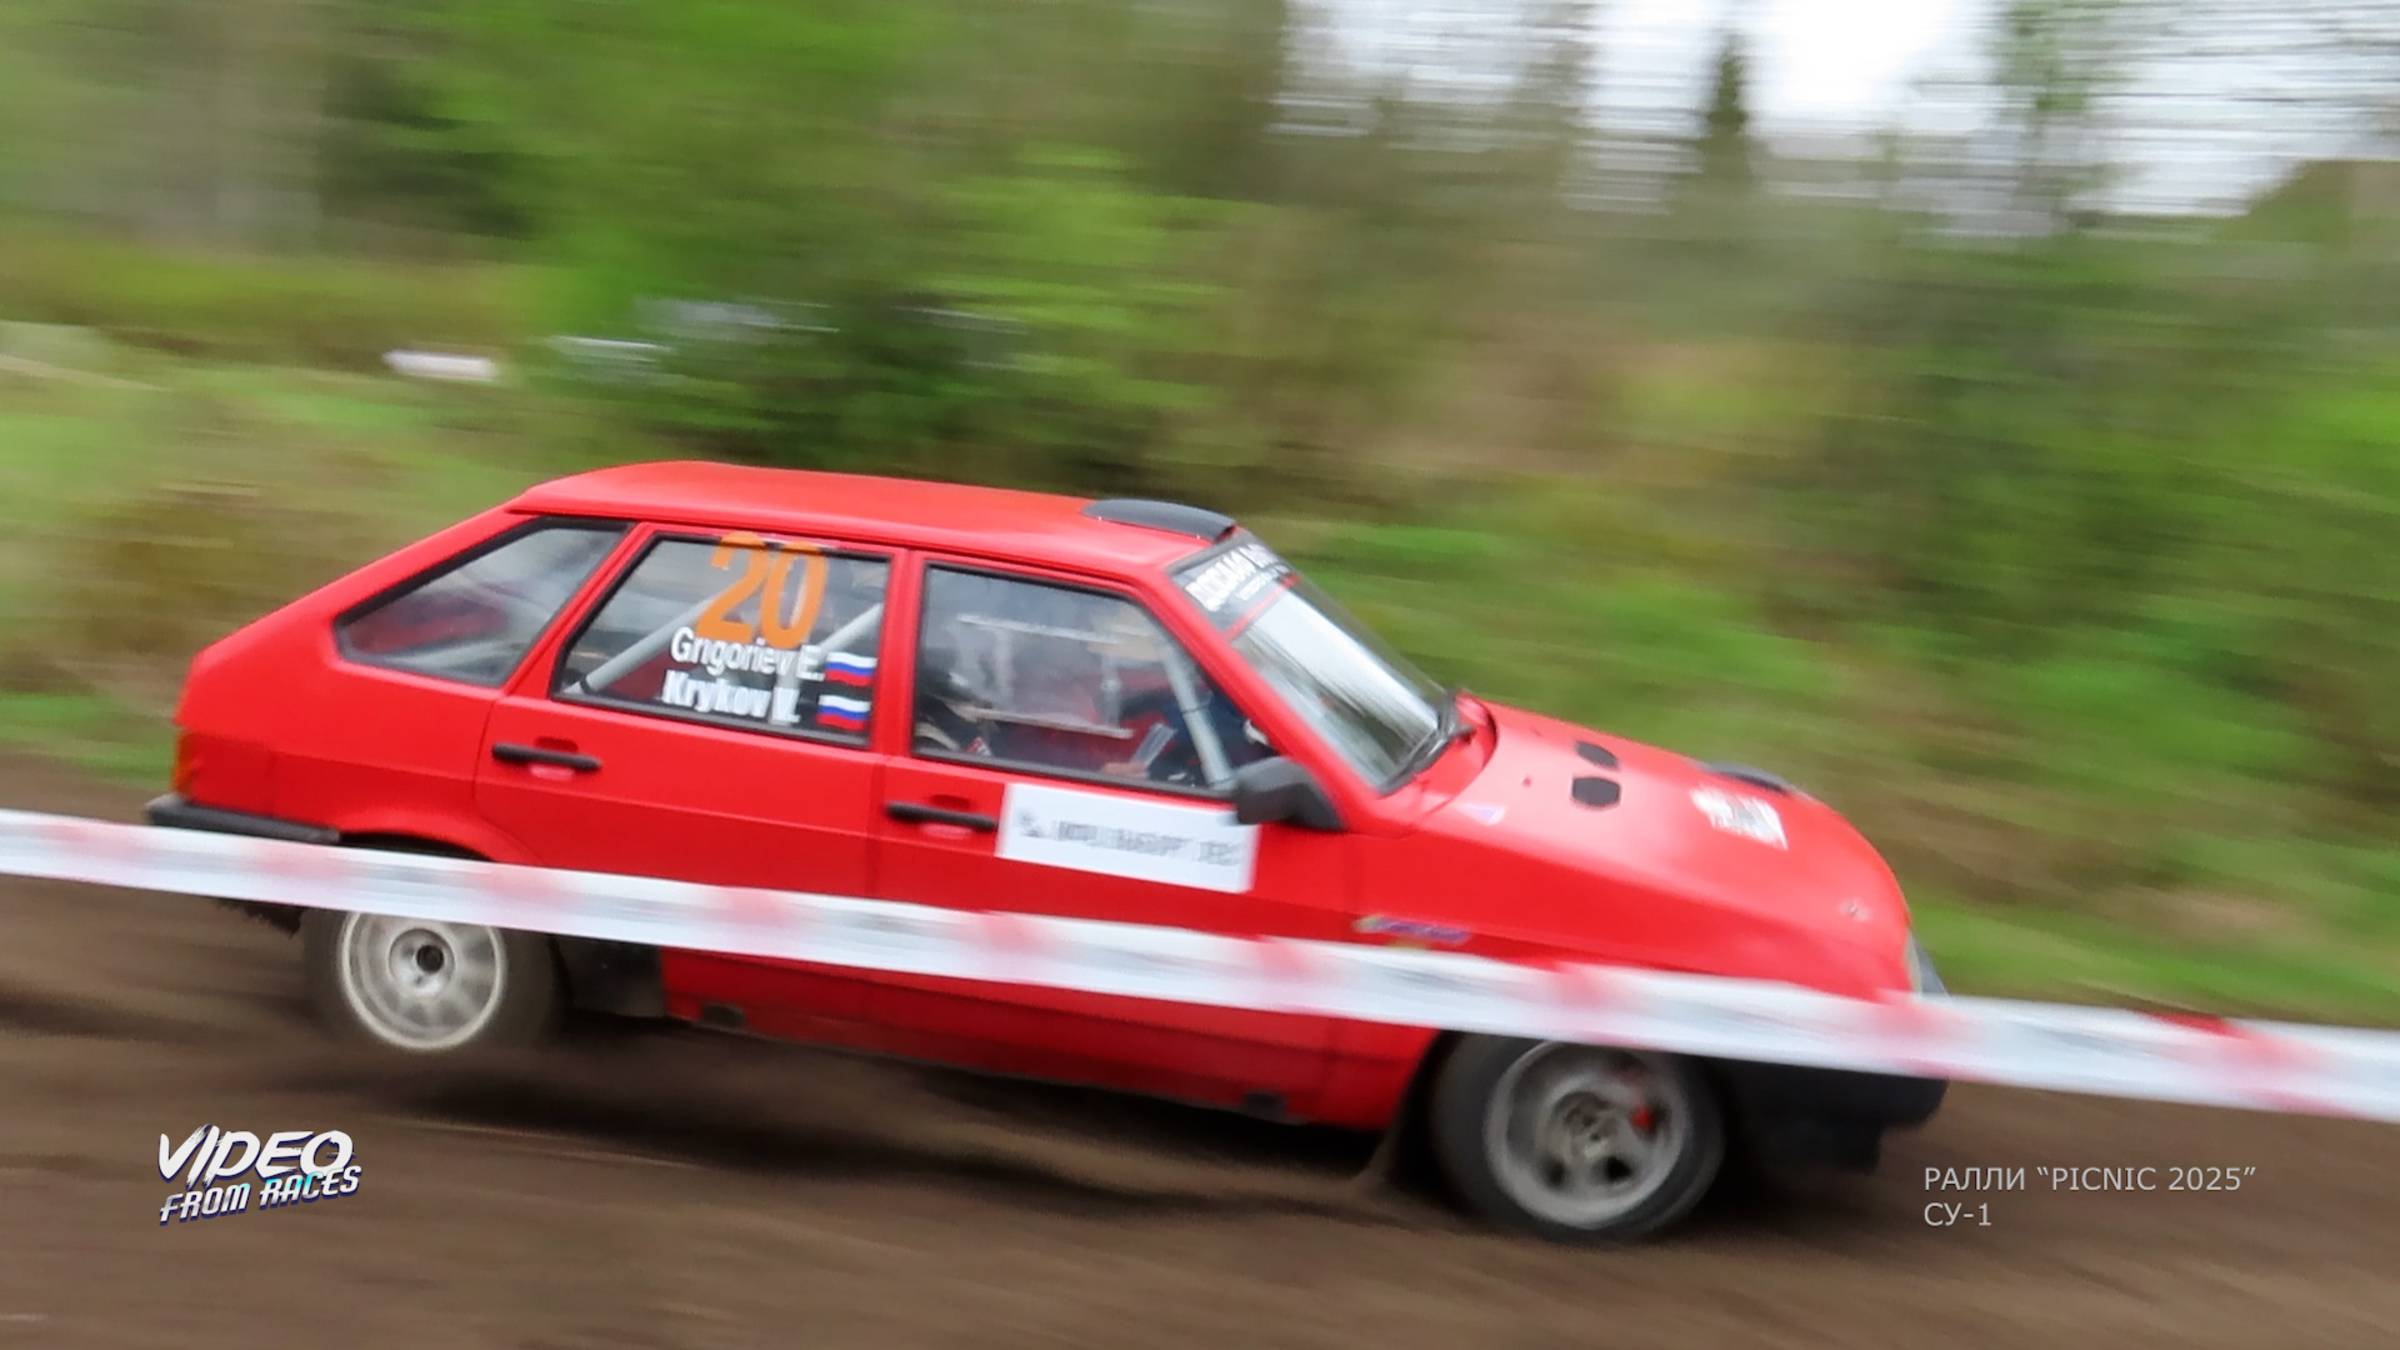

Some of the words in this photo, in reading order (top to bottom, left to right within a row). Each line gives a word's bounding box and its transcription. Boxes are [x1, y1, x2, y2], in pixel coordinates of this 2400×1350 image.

[696, 531, 829, 649] 20
[670, 626, 798, 676] Grigoriev
[662, 669, 772, 718] Krykov
